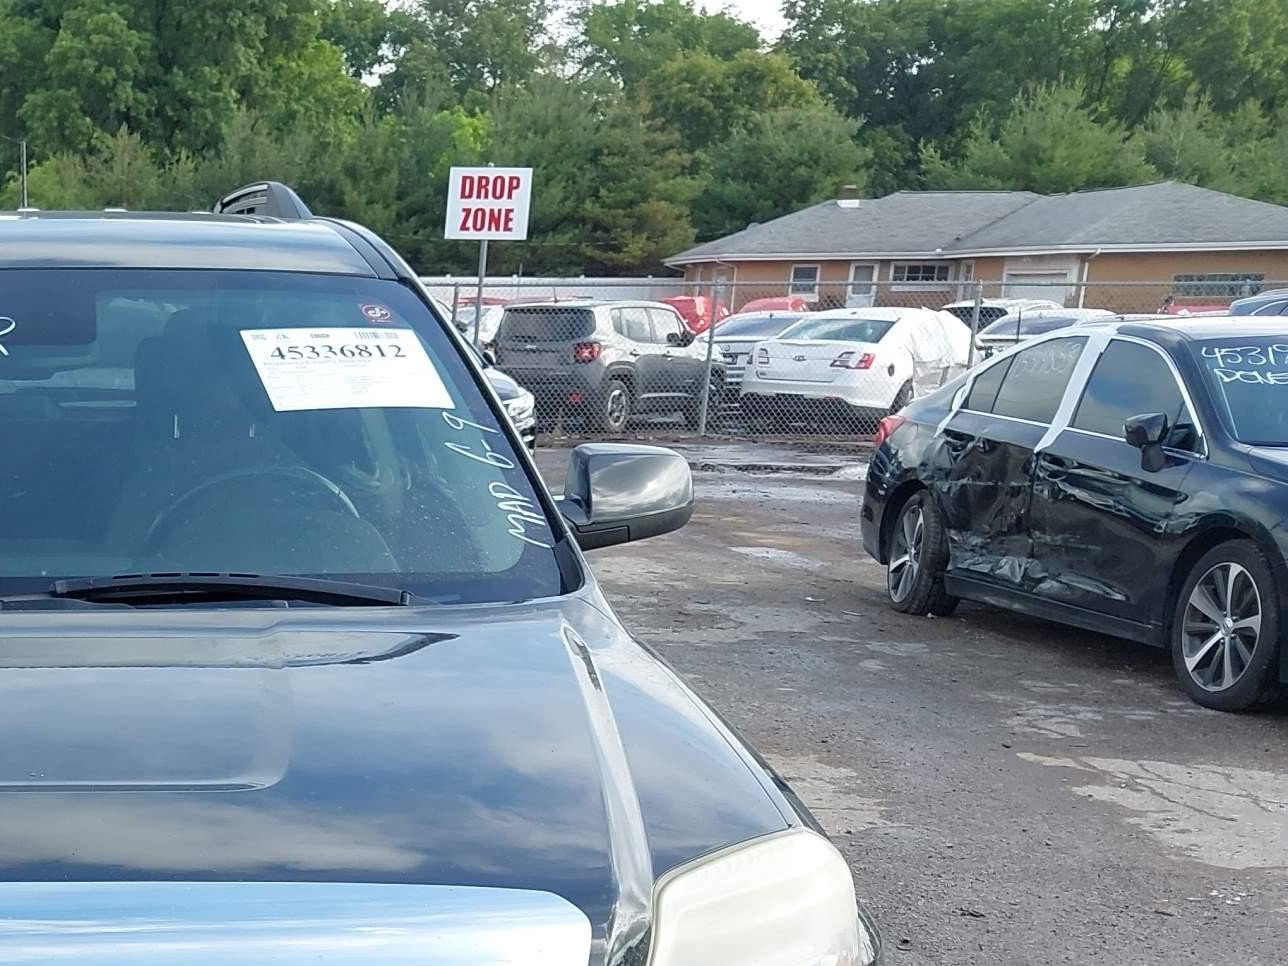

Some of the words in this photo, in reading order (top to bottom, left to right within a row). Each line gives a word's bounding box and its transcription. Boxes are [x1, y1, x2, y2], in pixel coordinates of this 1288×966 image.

[460, 175, 521, 200] DROP
[459, 207, 515, 232] ZONE
[270, 344, 407, 361] 45336812
